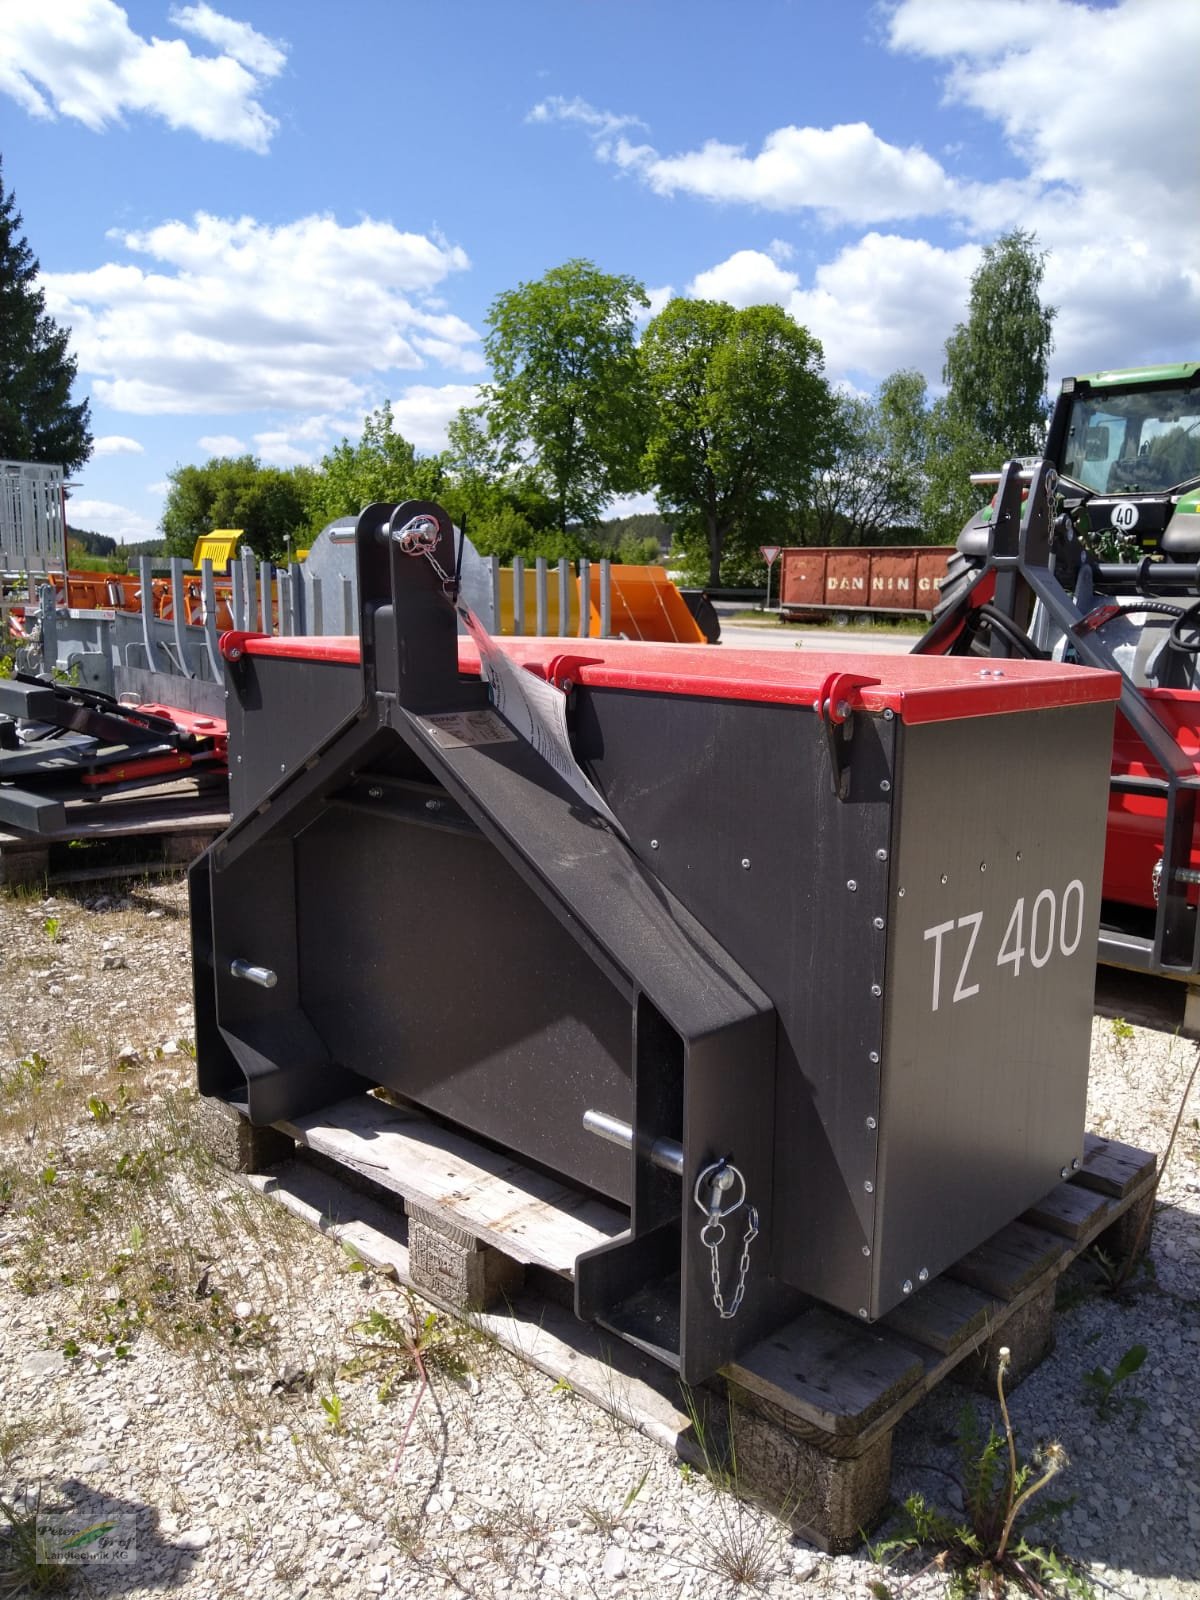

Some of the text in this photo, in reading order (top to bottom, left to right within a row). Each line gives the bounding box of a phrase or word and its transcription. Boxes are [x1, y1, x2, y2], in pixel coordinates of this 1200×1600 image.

[1116, 507, 1133, 526] 40
[924, 879, 1084, 1012] TZ 400
